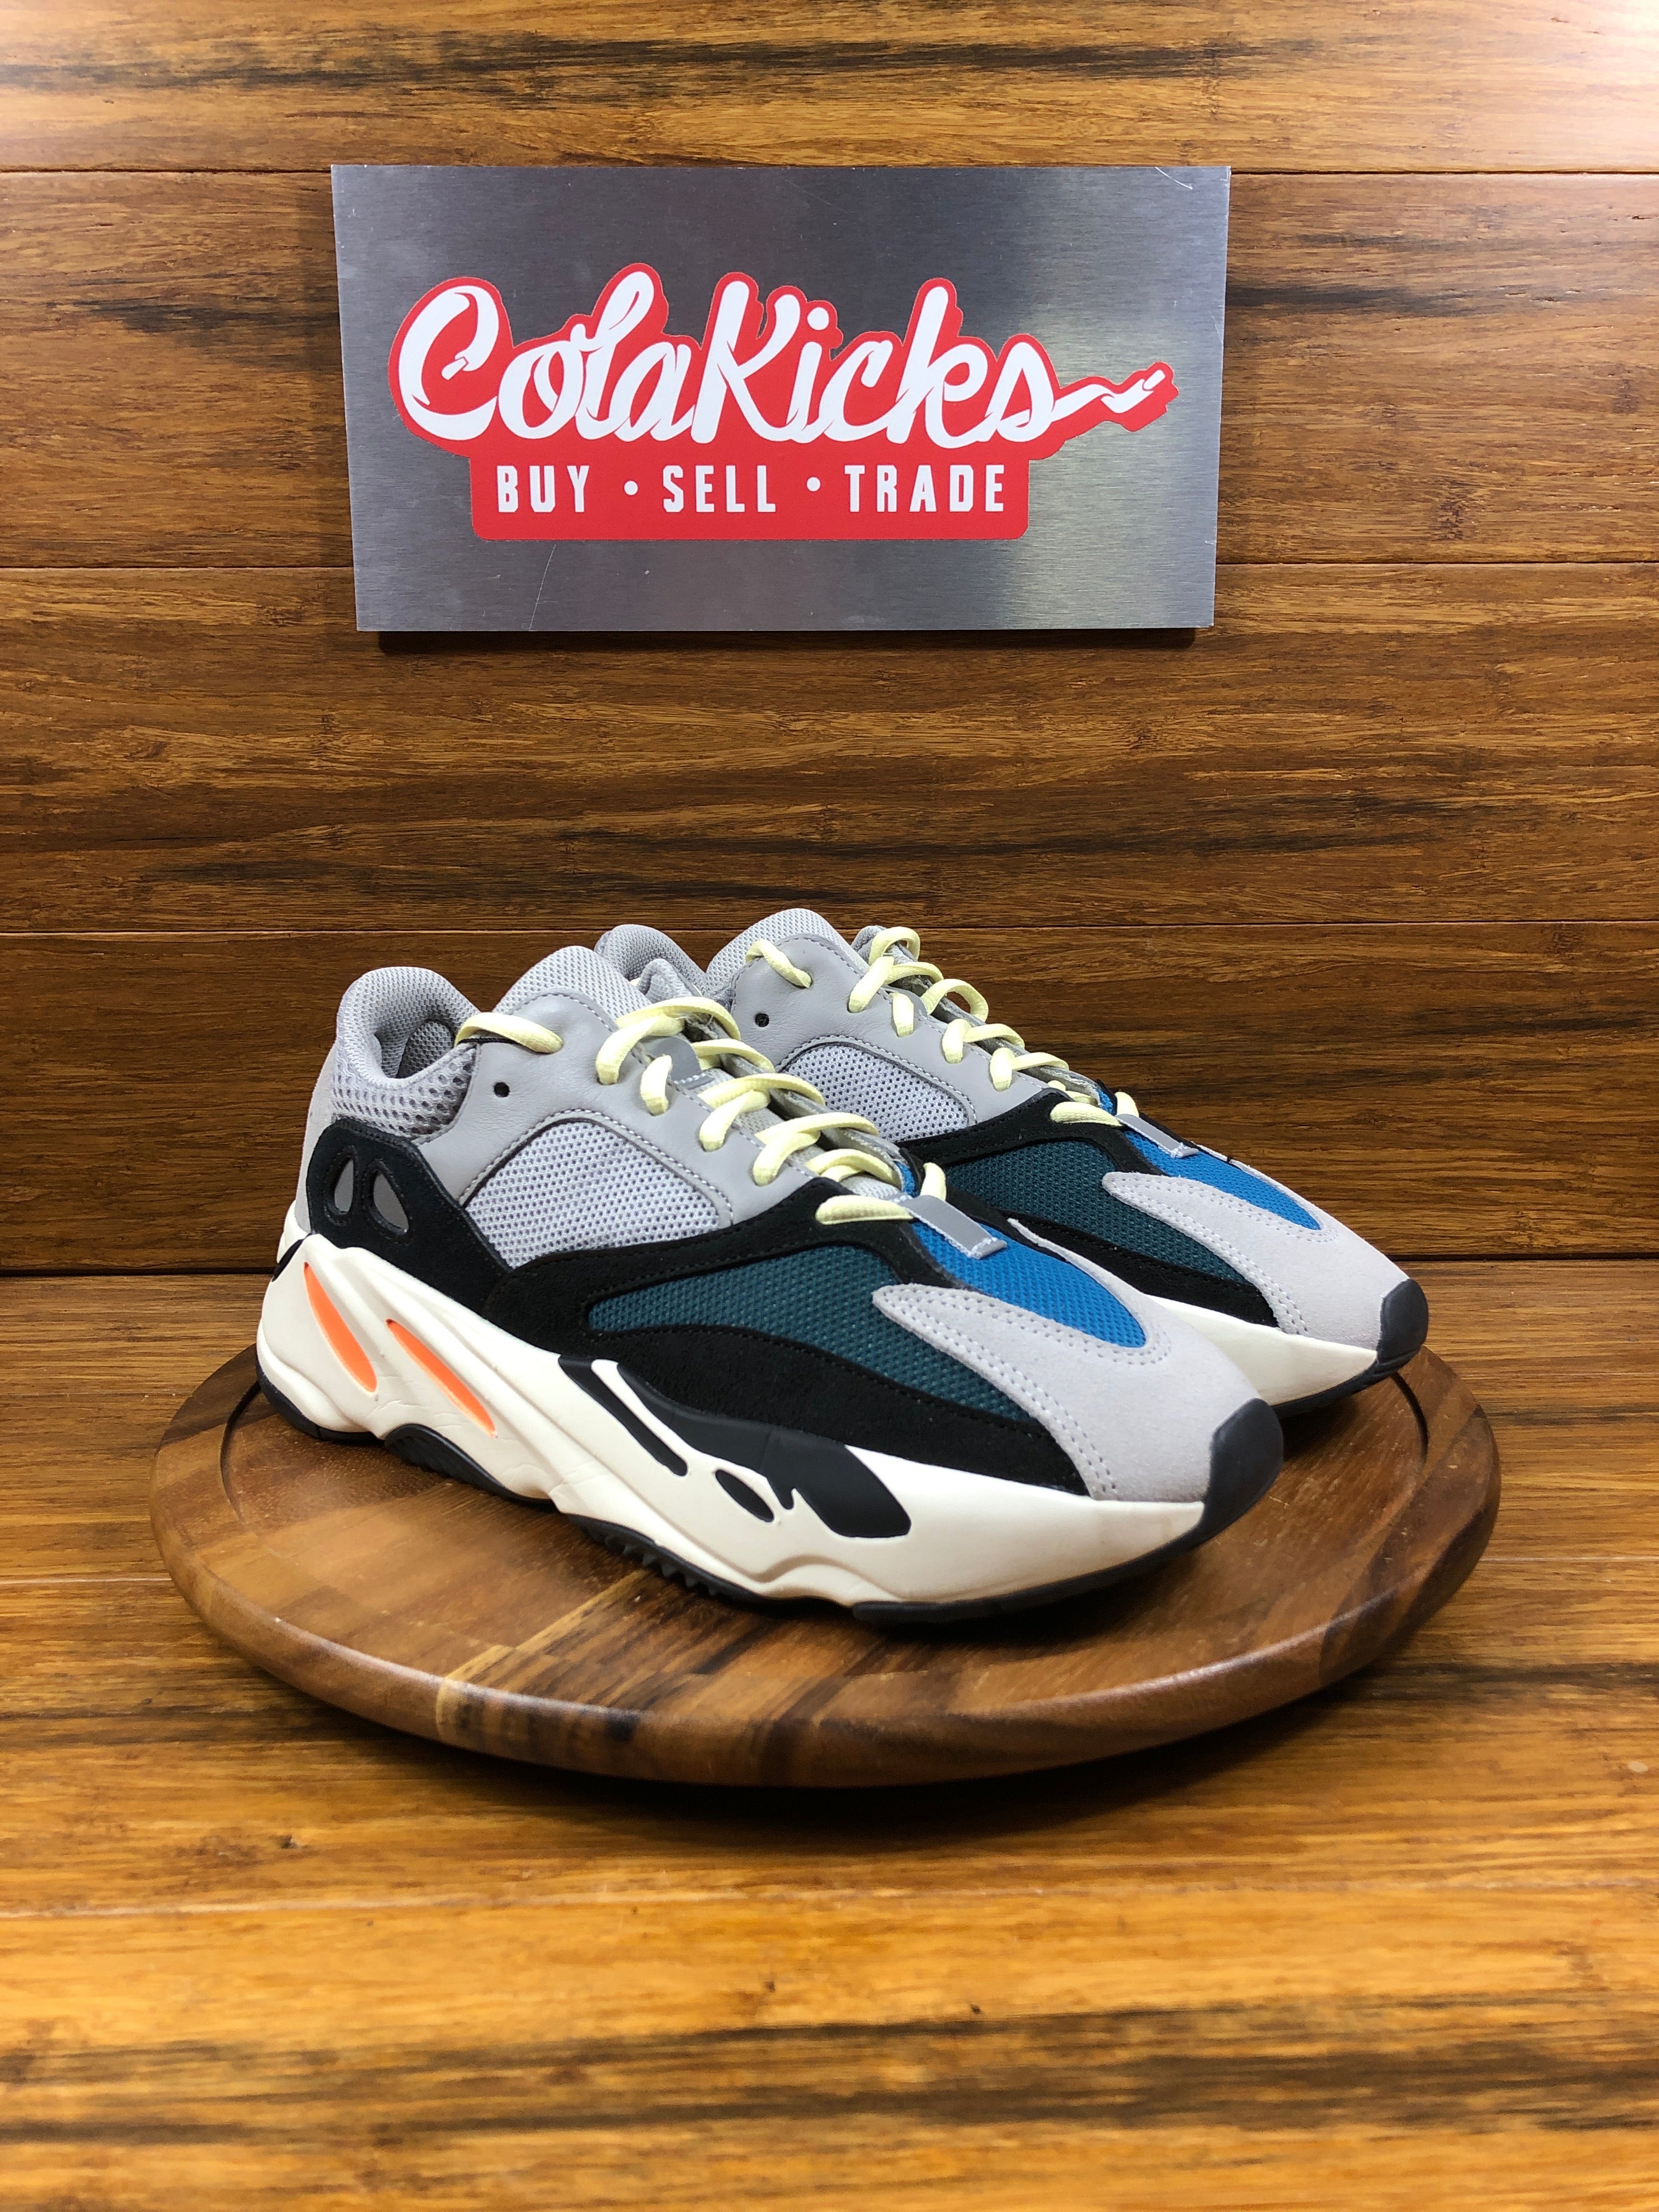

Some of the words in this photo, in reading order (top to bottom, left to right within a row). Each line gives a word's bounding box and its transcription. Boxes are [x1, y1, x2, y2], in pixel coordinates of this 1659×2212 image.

[497, 465, 589, 512] BUY
[663, 465, 776, 512] SELL
[844, 465, 1005, 512] TRADE
